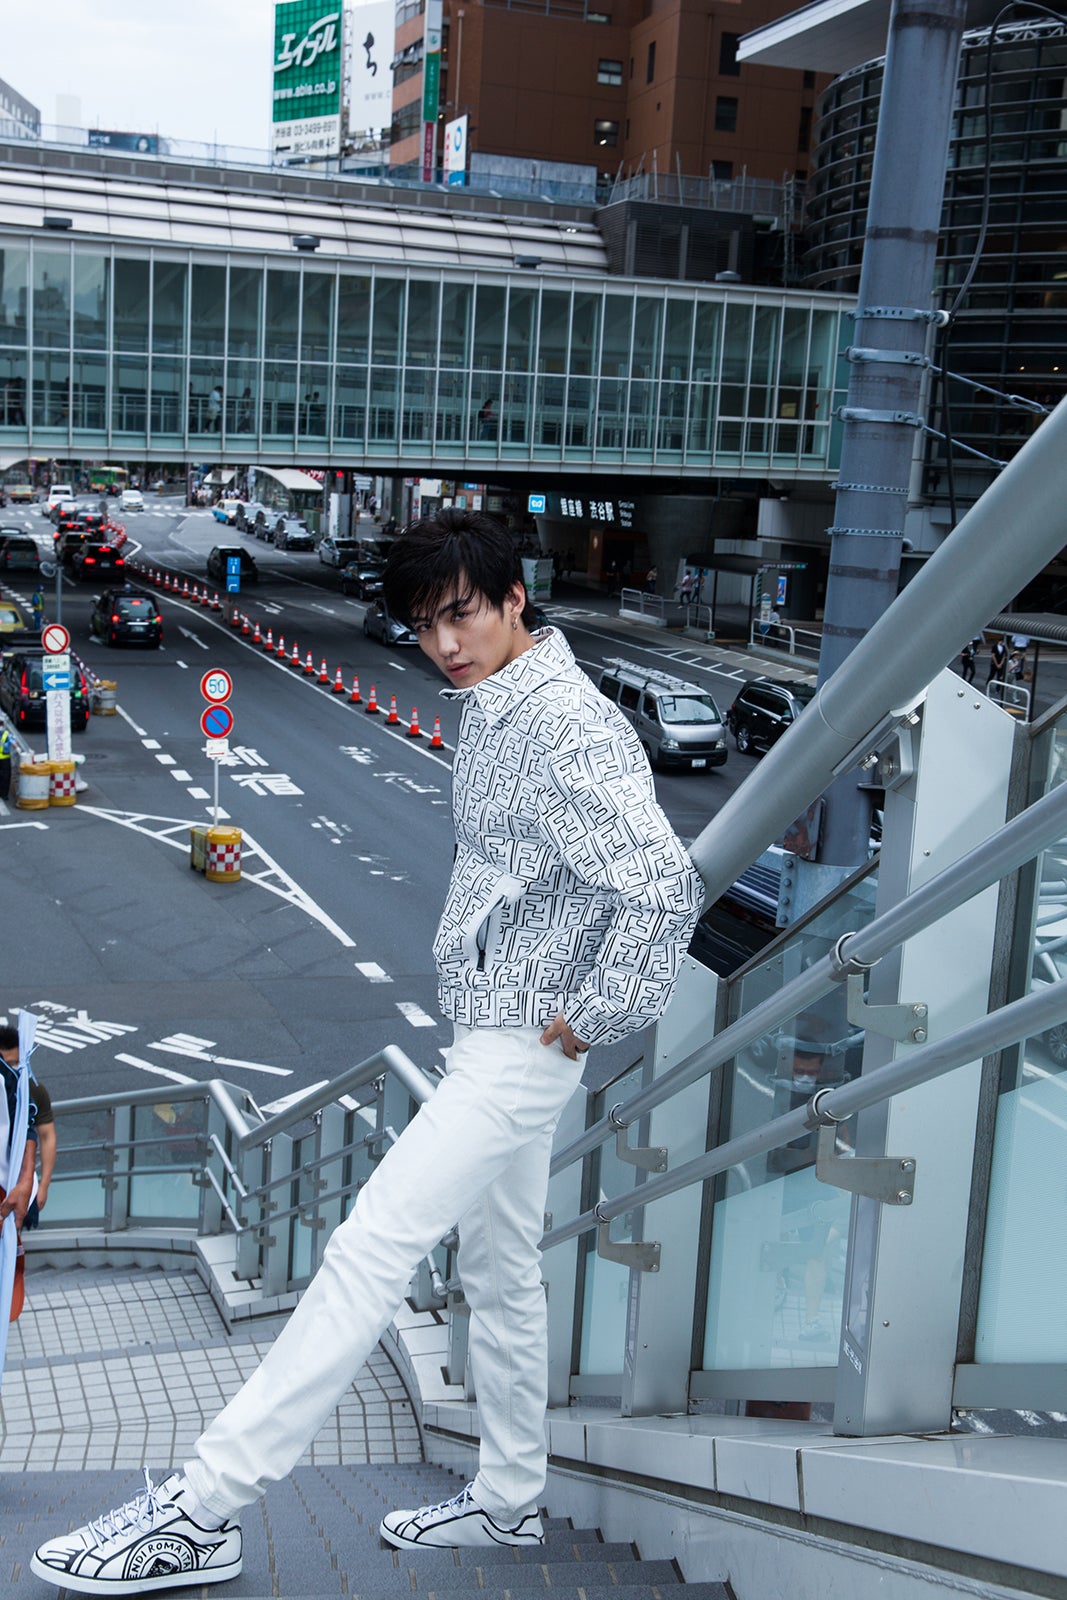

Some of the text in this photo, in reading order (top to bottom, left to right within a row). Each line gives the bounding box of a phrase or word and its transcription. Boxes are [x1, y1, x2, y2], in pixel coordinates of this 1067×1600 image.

[274, 12, 339, 72] エイブル
[589, 500, 614, 521] 渋谷駅
[209, 678, 226, 694] 50
[148, 1542, 182, 1554] ROMA
